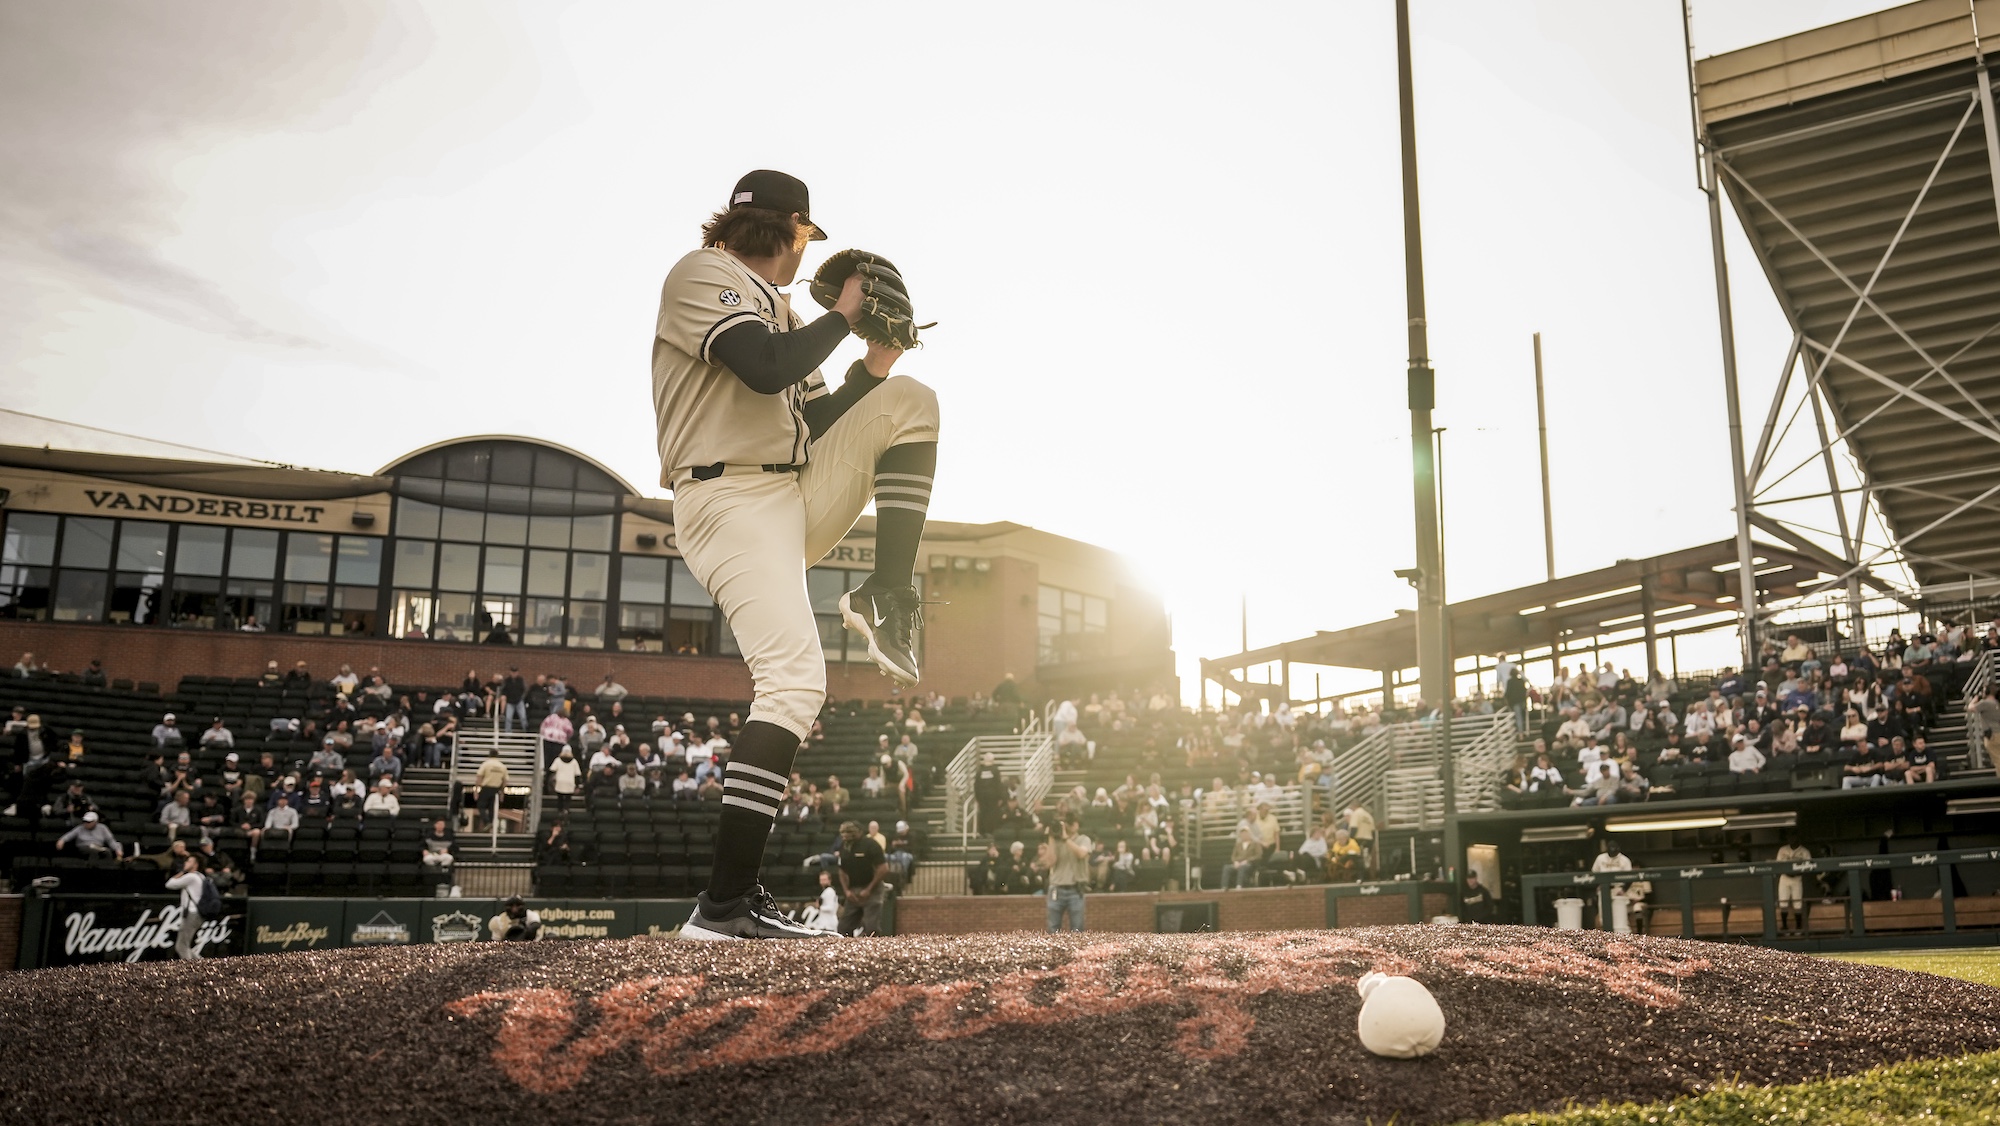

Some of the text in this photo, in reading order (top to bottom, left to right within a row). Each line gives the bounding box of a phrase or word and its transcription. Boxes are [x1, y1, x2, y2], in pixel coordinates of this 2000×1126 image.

[719, 289, 740, 306] SEC
[84, 490, 325, 523] VANDERBILT
[64, 905, 232, 963] VandyBys
[256, 922, 329, 949] VandyBoys
